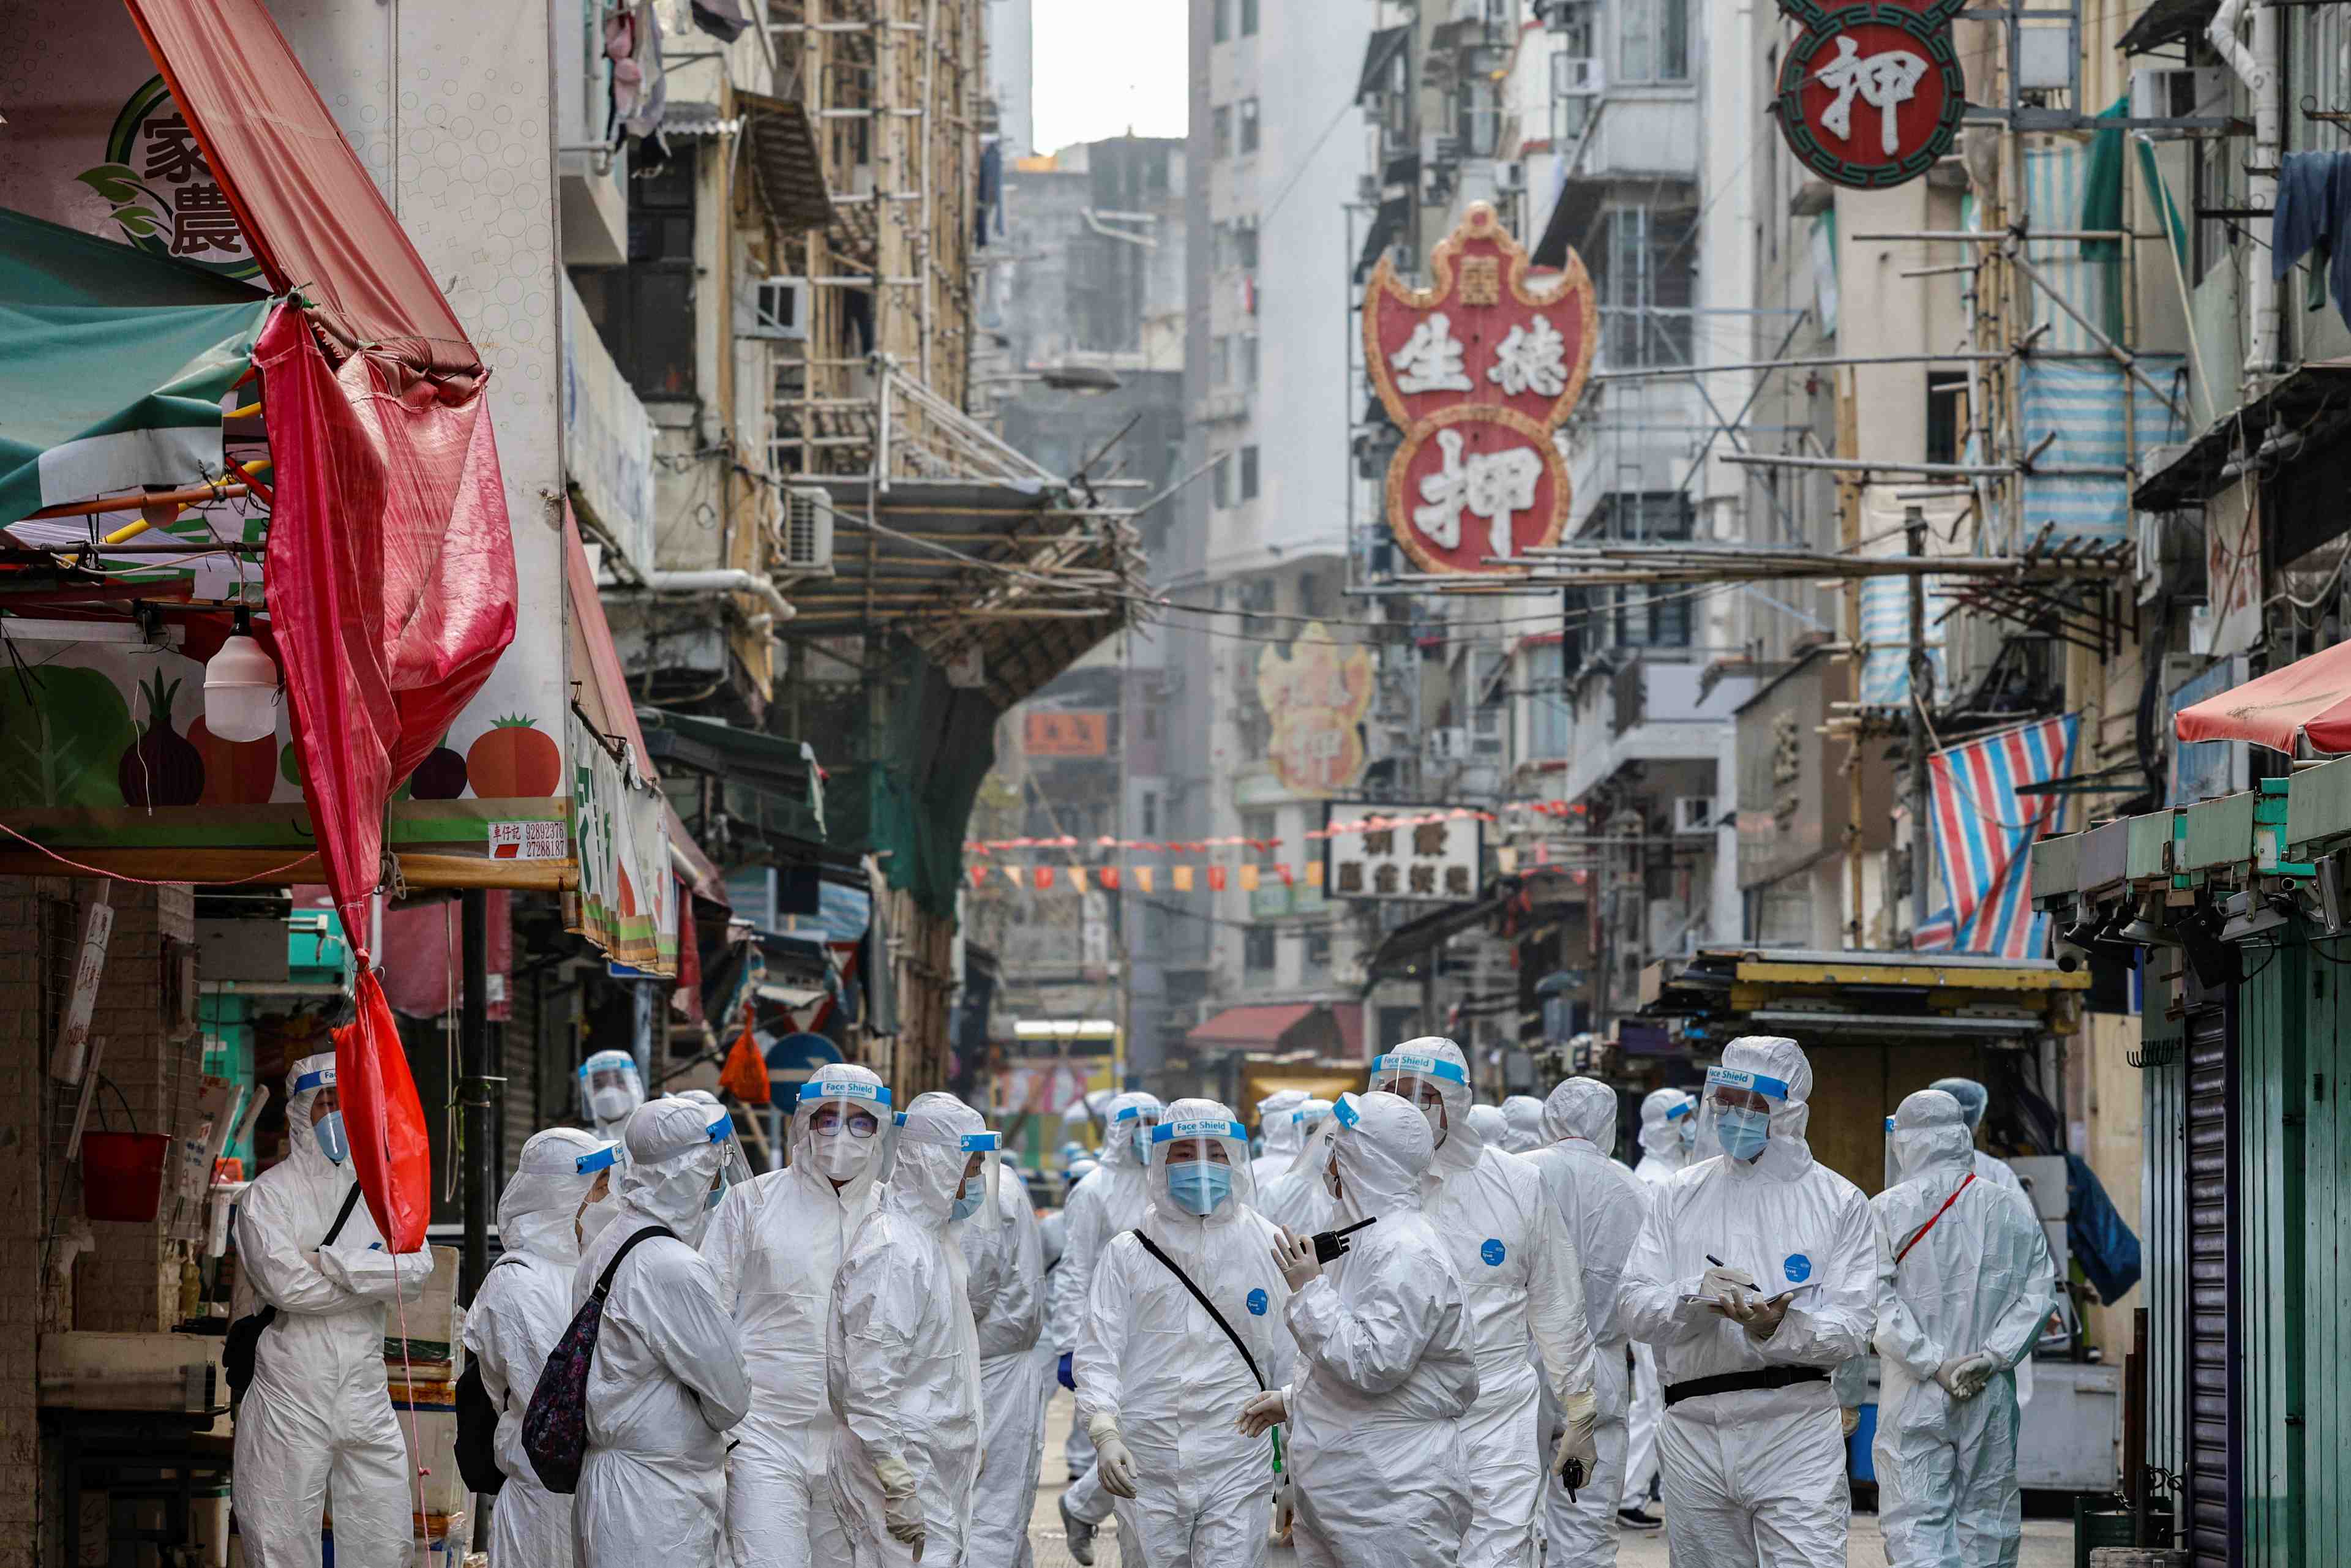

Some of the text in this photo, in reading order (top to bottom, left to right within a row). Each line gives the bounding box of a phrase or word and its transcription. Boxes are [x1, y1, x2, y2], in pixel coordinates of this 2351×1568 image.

[1815, 35, 1929, 156] 押
[143, 113, 212, 184] 家
[170, 182, 242, 255] 農
[1413, 428, 1543, 560] 押
[493, 823, 521, 842] 車仔記
[525, 823, 564, 840] 92892376
[527, 840, 564, 857] 27288187
[1401, 1056, 1430, 1067] Shield
[1722, 1070, 1749, 1082] Shield
[848, 1083, 872, 1094] Shield
[1199, 1121, 1226, 1130] Shield
